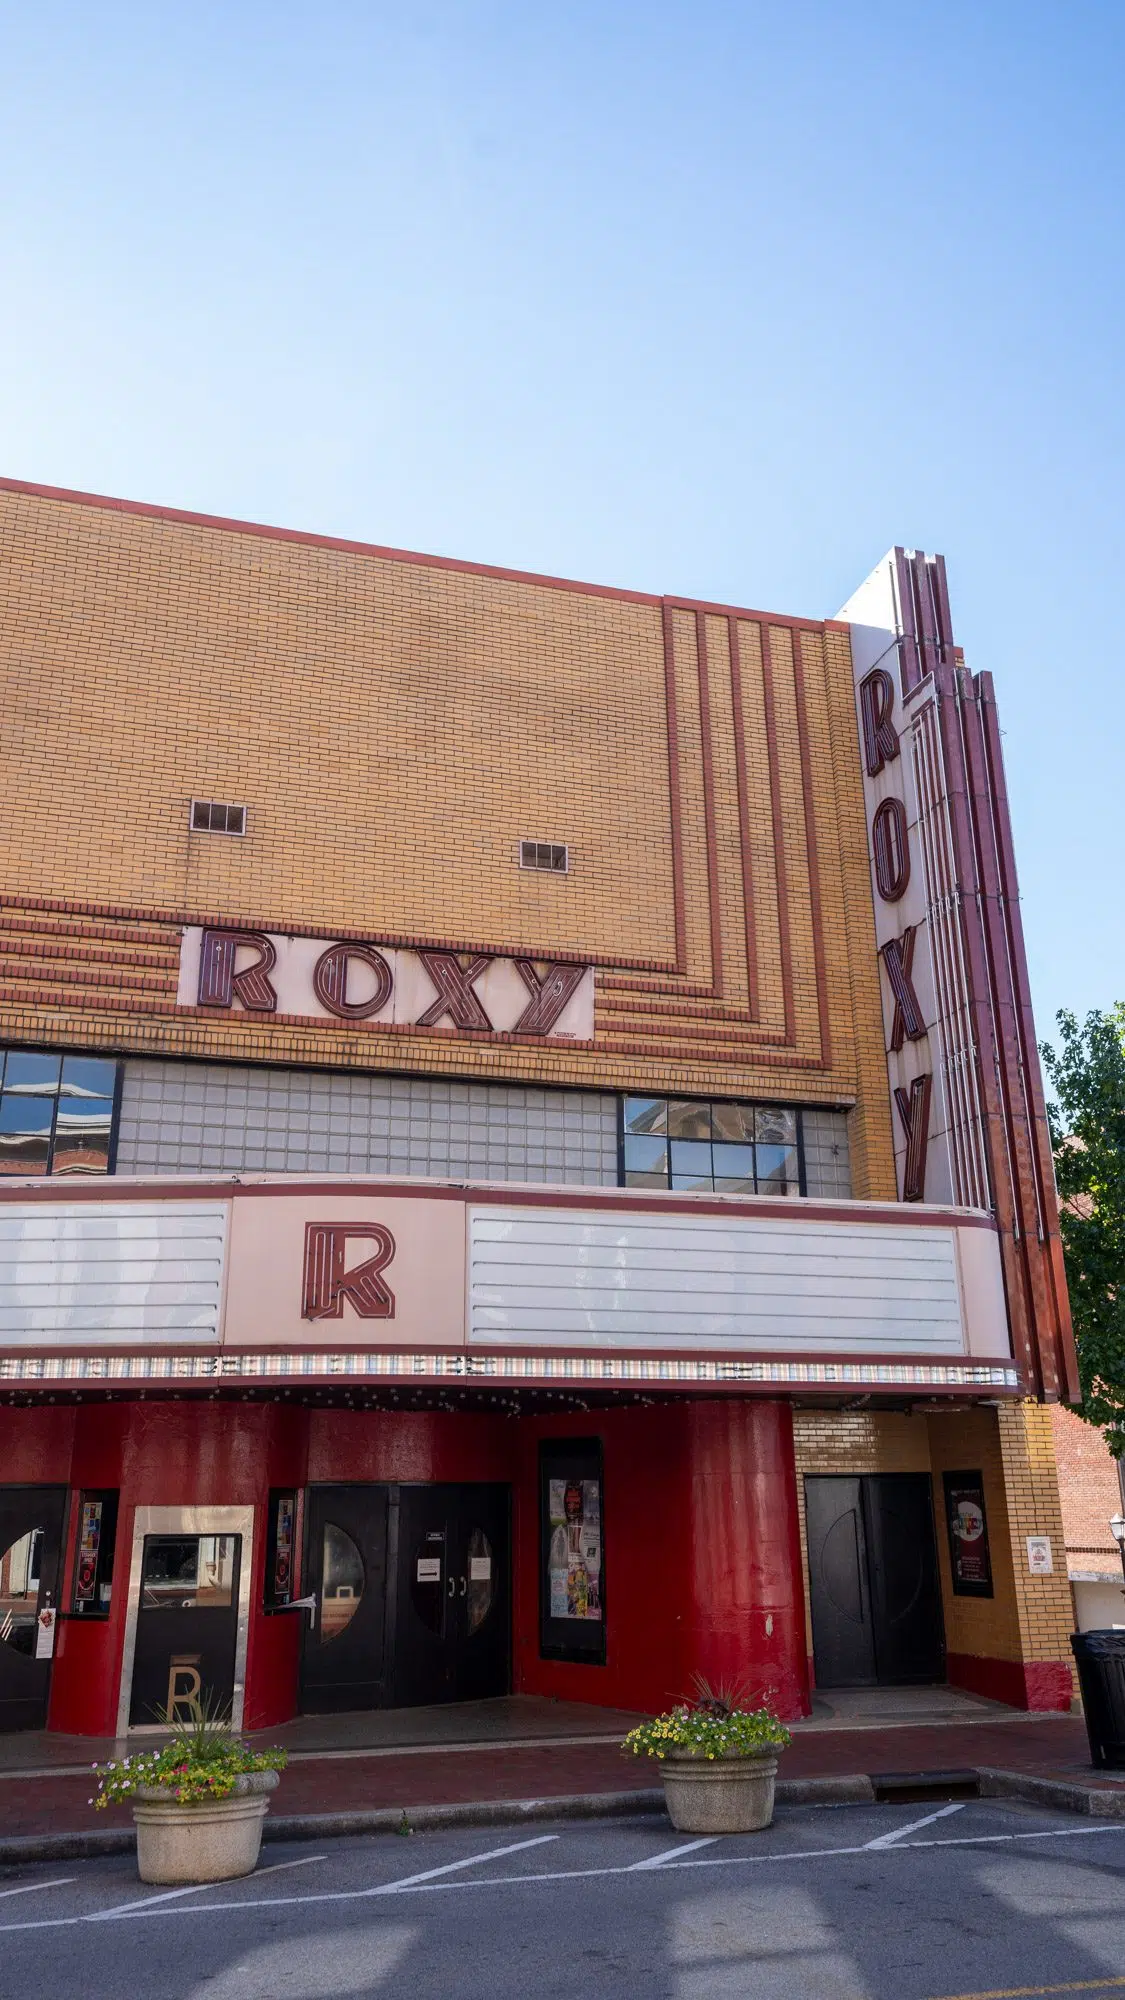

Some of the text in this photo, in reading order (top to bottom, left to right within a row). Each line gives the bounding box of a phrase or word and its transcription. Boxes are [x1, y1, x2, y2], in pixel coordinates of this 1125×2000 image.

[197, 926, 589, 1035] ROXY
[860, 668, 932, 1201] ROXY
[301, 1222, 396, 1319] R
[167, 1666, 203, 1723] R
